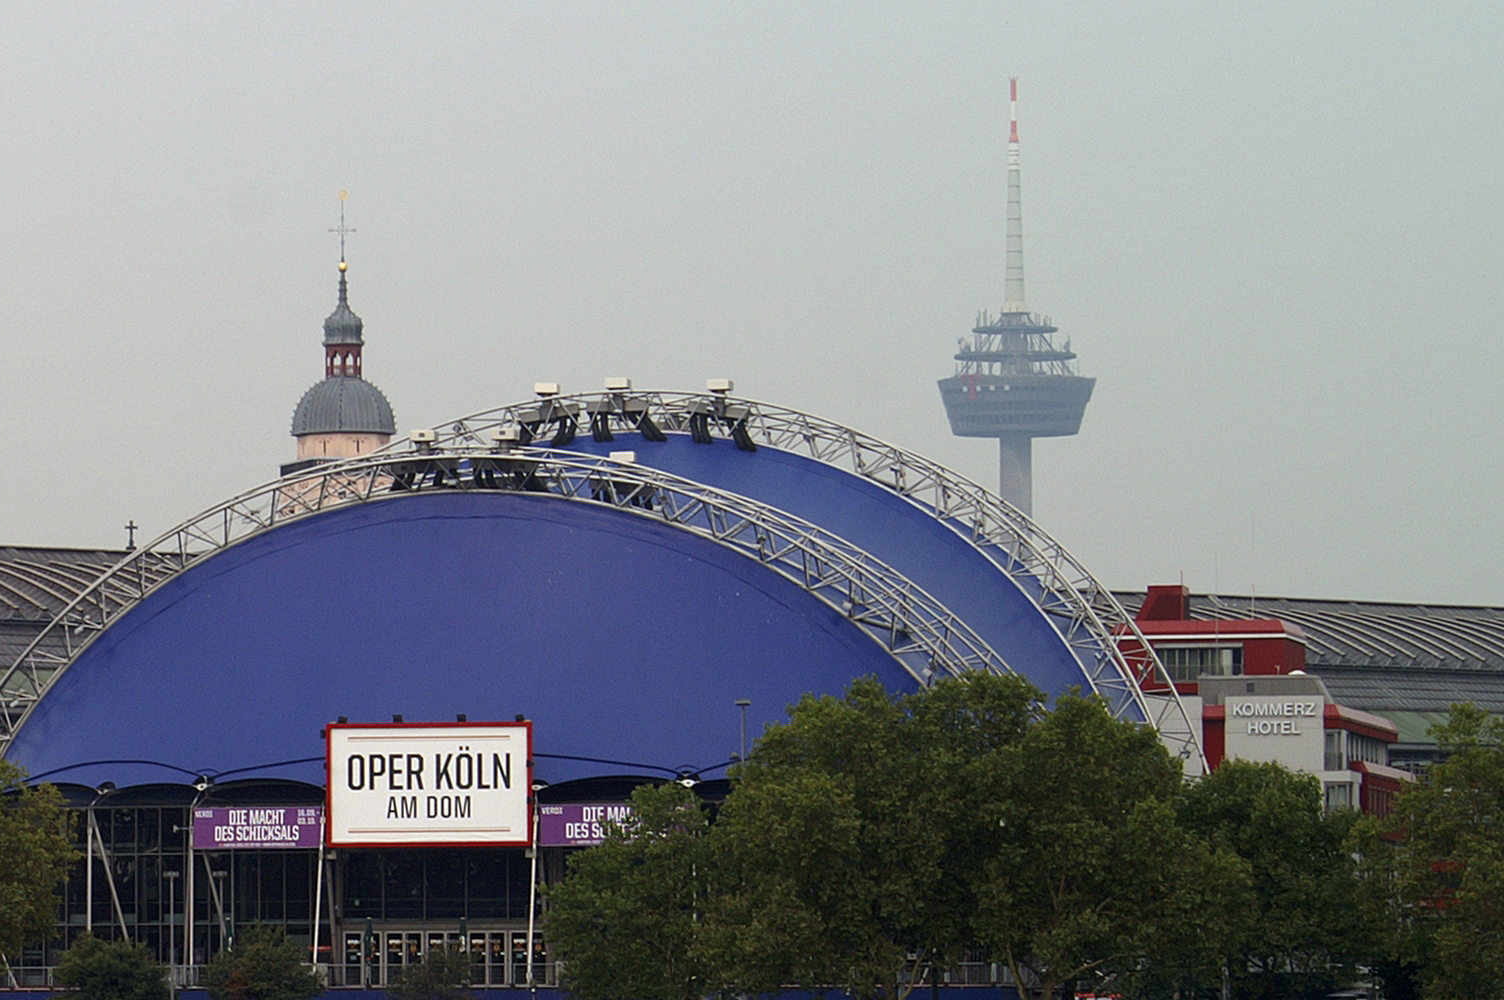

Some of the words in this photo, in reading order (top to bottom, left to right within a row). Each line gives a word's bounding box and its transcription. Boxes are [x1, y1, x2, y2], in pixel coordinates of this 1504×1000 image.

[1232, 702, 1316, 717] KOMMERZ
[1247, 720, 1301, 735] HOTEL
[347, 753, 425, 791] OPER
[435, 745, 511, 790] KÖLN
[386, 795, 418, 819] AM
[426, 795, 472, 819] DOM
[582, 806, 605, 822] DIE
[228, 809, 248, 826] DIE
[249, 809, 286, 825] MACHT
[214, 825, 235, 842] DES
[236, 825, 300, 841] SCHICKSALS
[565, 822, 589, 839] DES
